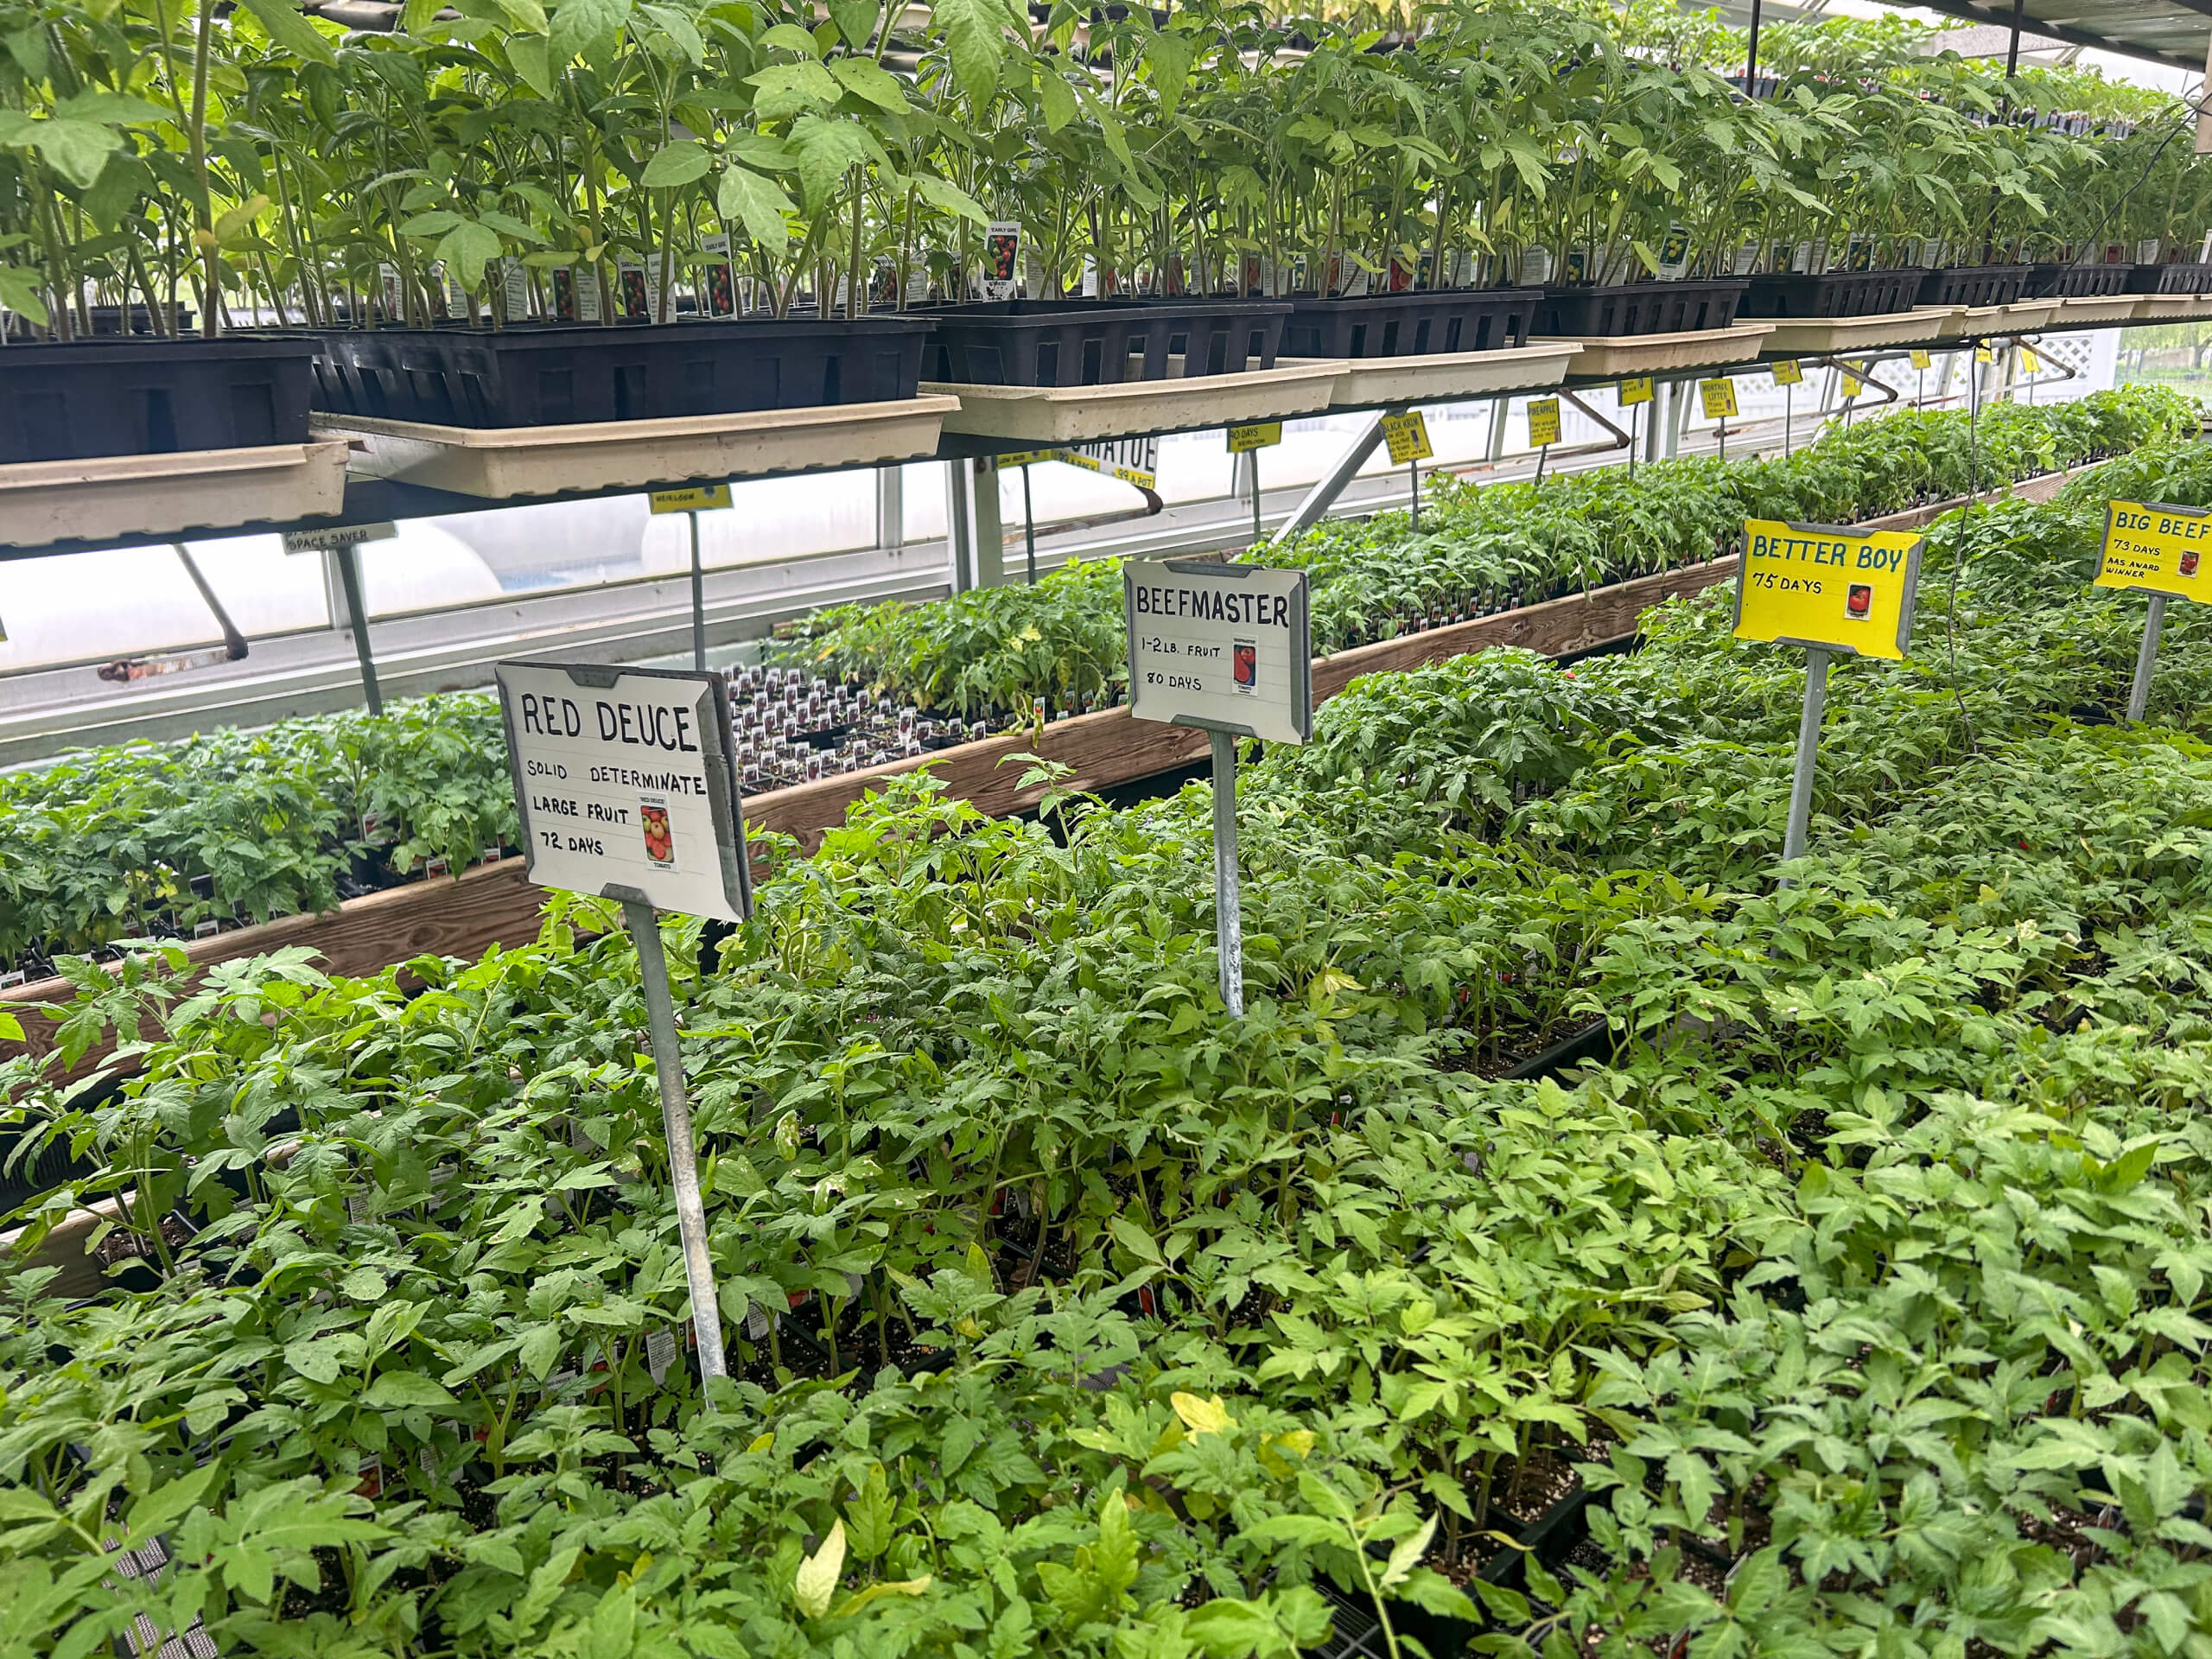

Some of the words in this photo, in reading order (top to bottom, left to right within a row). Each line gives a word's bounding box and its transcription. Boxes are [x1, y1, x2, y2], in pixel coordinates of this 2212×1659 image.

[1242, 428, 1259, 438] DAYS
[2115, 512, 2151, 531] BIG
[2158, 518, 2211, 539] BEEF
[288, 537, 327, 551] SPACE
[331, 530, 368, 544] SAVER
[2113, 539, 2130, 550] 73
[2133, 544, 2160, 556] DAYS
[1752, 535, 1847, 567] BETTER
[1856, 545, 1903, 572] BOY
[2108, 557, 2126, 566] AAS
[2129, 562, 2159, 571] AWARD
[1752, 572, 1778, 588] 75
[1780, 577, 1822, 594] DAYS
[2106, 567, 2145, 578] WINNER
[1136, 586, 1289, 628] BEEFMASTER
[1188, 645, 1220, 658] FRUIT
[1147, 672, 1164, 685] 80
[1169, 677, 1202, 691] DAYS
[522, 693, 581, 737] RED
[596, 702, 697, 752] DEUCE
[527, 760, 567, 779] SOLID
[590, 766, 707, 795] DETERMINATE
[533, 796, 579, 817] LARGE
[588, 804, 628, 824] FRUIT
[540, 831, 563, 850] 72
[569, 836, 604, 855] DAYS
